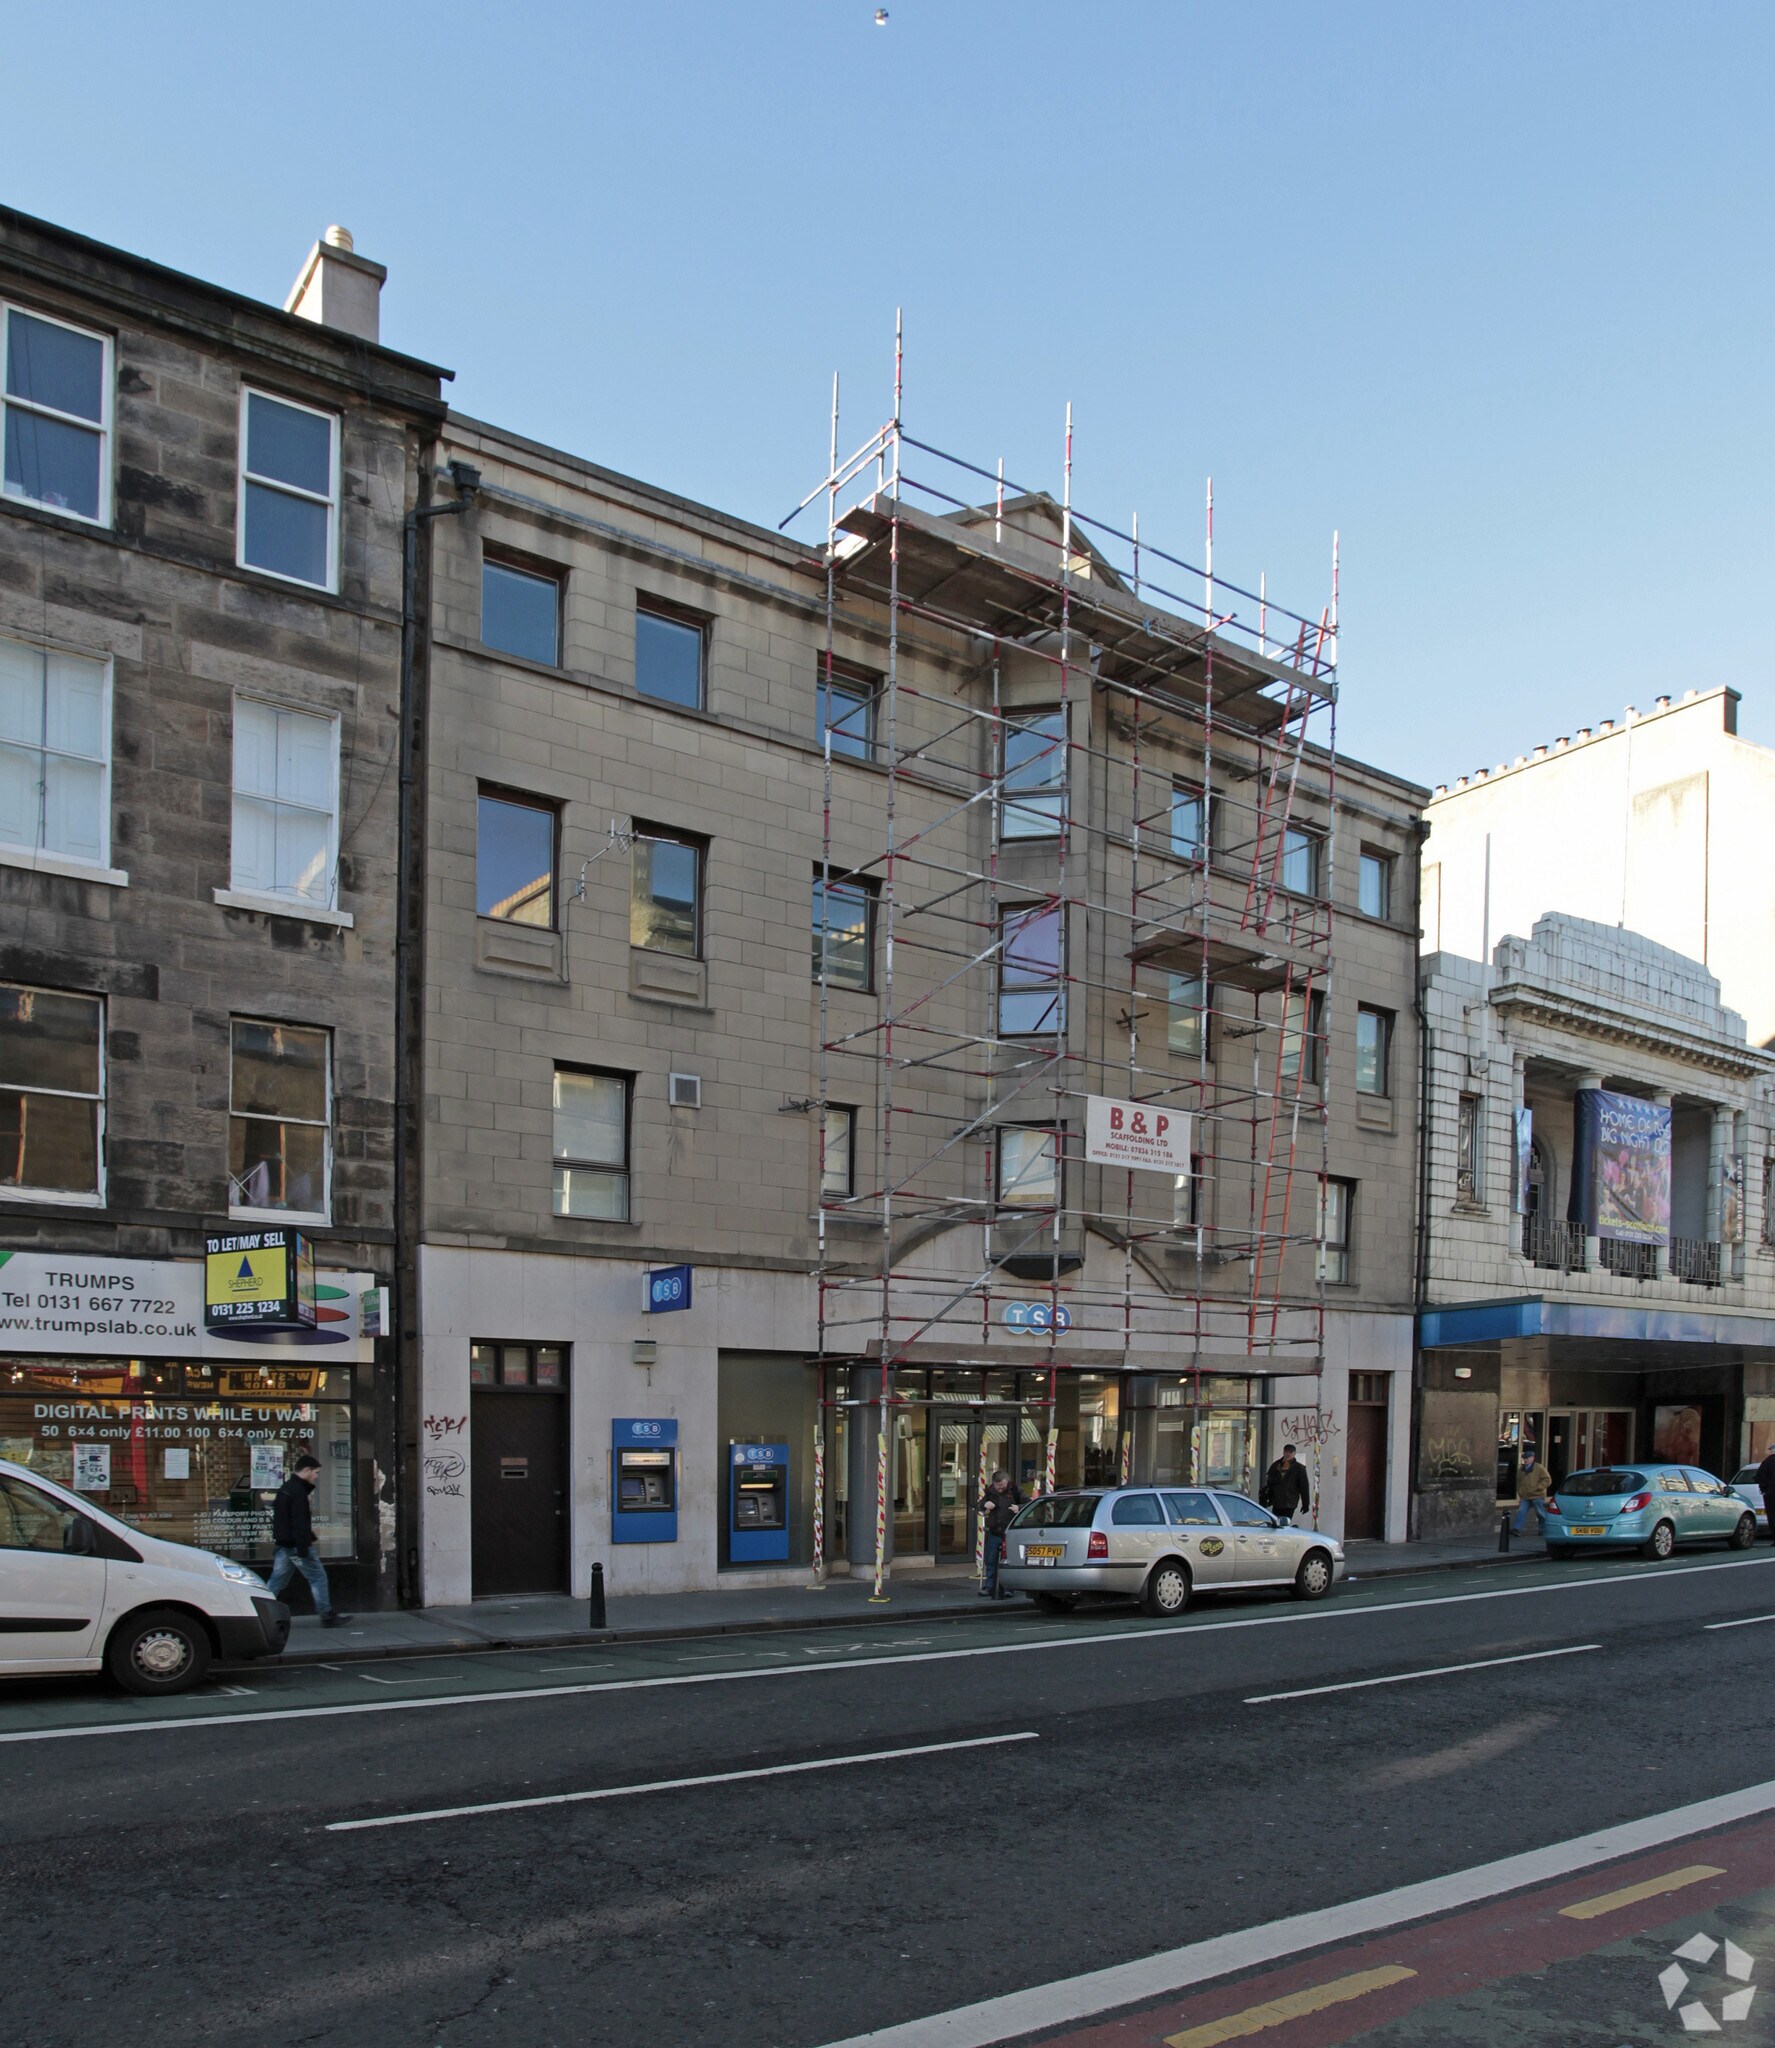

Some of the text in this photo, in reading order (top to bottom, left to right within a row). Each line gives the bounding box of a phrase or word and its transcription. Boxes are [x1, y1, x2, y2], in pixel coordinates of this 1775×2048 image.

[1111, 1107, 1169, 1137] B & P
[1600, 1109, 1634, 1130] HOME
[1638, 1117, 1650, 1133] OF
[1105, 1142, 1130, 1152] MOBILE:
[1111, 1132, 1168, 1147] SCAFFOLDING LTD
[1600, 1127, 1618, 1144] BIG
[1620, 1131, 1650, 1150] NIGHT
[207, 1232, 286, 1253] TO LET/MAY SELL
[45, 1272, 135, 1290] TRUMPS
[228, 1277, 263, 1288] SHEPHERD
[654, 1281, 680, 1298] TSB
[2, 1292, 175, 1314] Tel 0131 667 7722
[212, 1300, 280, 1316] 0131 225 1234
[1011, 1308, 1067, 1328] TSB
[34, 1404, 113, 1420] DIGITAL
[119, 1405, 188, 1421] PRINTS
[194, 1407, 253, 1422] WHILE
[258, 1408, 270, 1422] U
[41, 1425, 59, 1437] 50
[100, 1426, 131, 1440] only
[135, 1427, 181, 1439] £11.00
[186, 1427, 211, 1439] 100
[247, 1428, 276, 1441] only
[279, 1428, 315, 1440] £7.50
